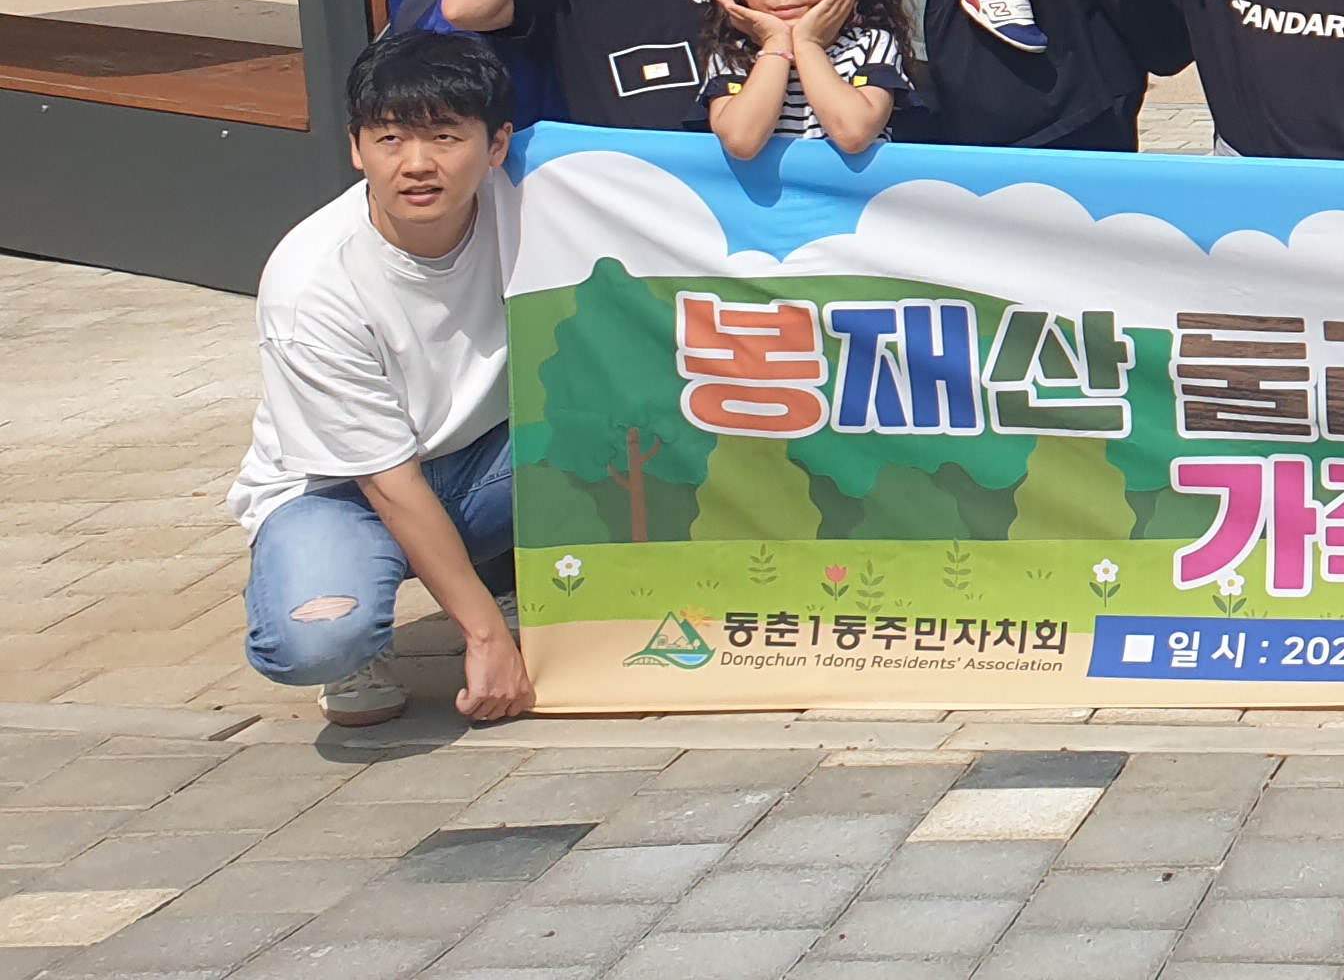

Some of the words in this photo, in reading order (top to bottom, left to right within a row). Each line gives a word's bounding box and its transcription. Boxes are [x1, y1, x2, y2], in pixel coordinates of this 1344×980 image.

[678, 294, 1131, 435] 봉재산
[723, 611, 1068, 654] 동춘1동주민자치회
[720, 652, 807, 669] Dongchun
[814, 653, 866, 671] 1dong
[870, 655, 961, 670] Residents'
[963, 658, 1063, 672] Association
